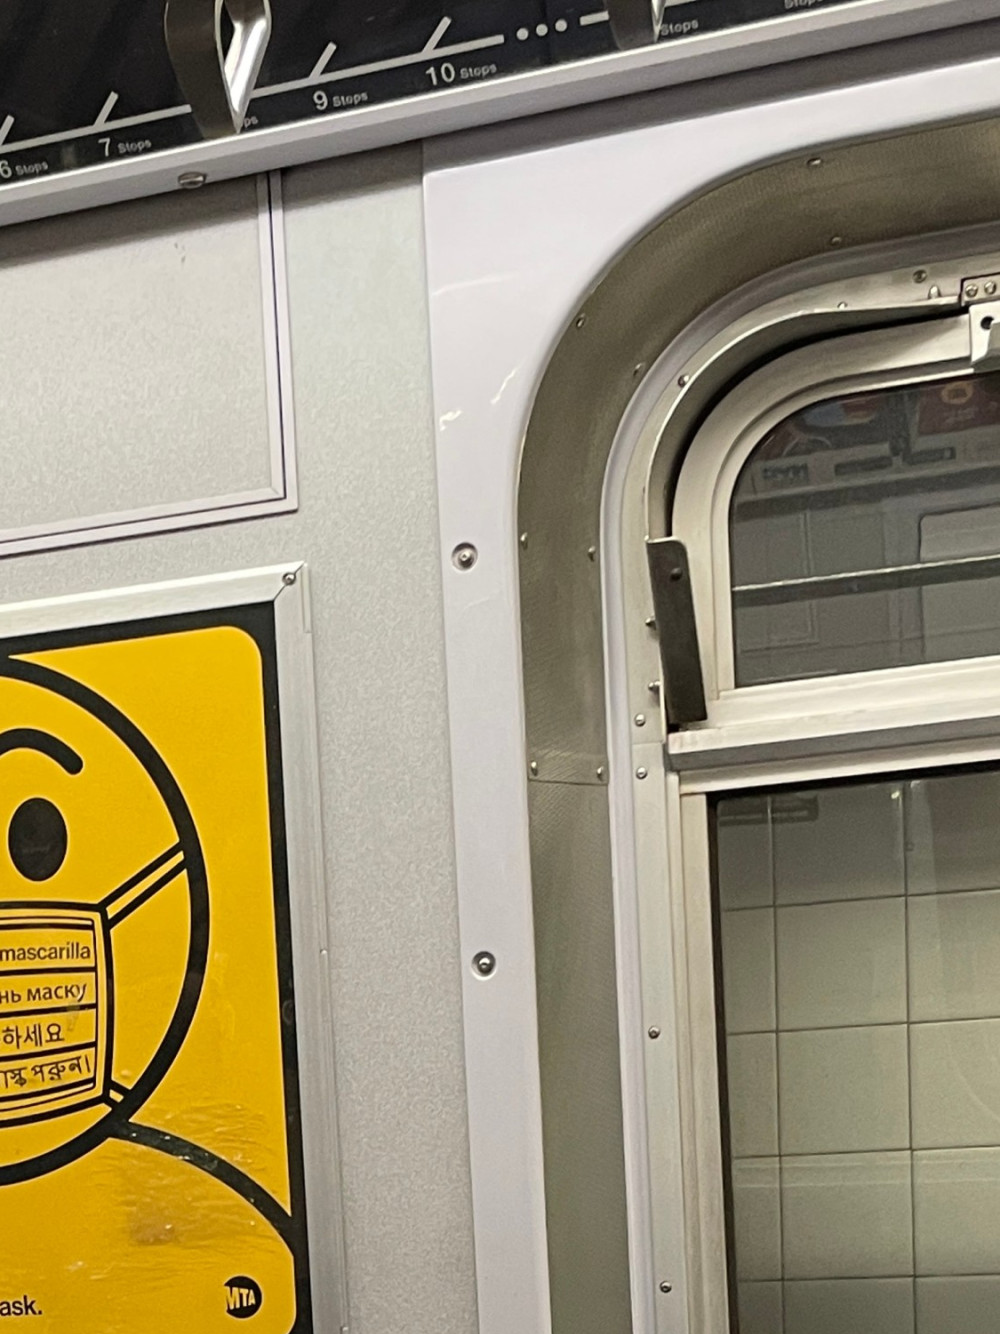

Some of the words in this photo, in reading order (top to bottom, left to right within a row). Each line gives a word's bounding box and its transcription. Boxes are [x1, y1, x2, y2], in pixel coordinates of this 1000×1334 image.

[426, 63, 456, 86] 10
[460, 62, 497, 78] Stops
[313, 90, 329, 111] 9
[333, 91, 369, 108] Stops
[98, 137, 112, 158] 7
[118, 138, 152, 154] Stops
[15, 160, 49, 176] Stops
[0, 941, 91, 961] mascarilla
[27, 983, 88, 1002] маску
[225, 1285, 256, 1310] MTA
